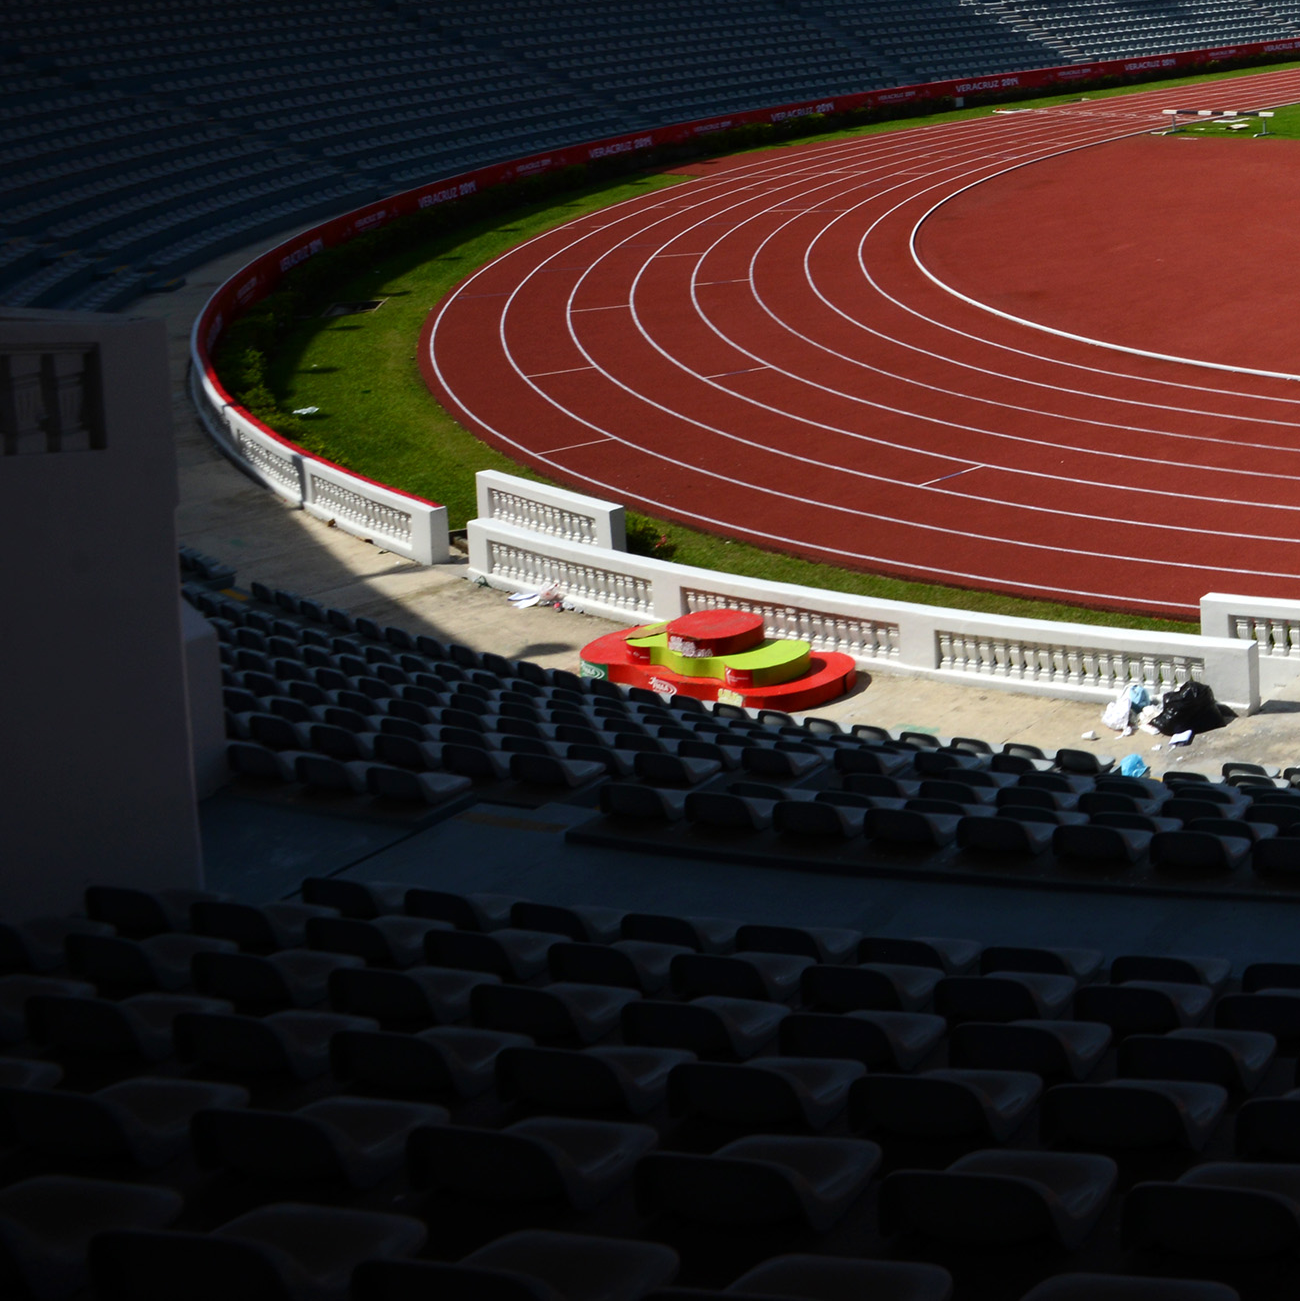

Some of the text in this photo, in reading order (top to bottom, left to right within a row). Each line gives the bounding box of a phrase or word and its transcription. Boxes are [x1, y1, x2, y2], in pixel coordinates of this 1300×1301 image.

[1125, 61, 1160, 71] VERACRUZ
[956, 77, 1018, 92] VERACRUZ 2014
[771, 106, 813, 122] VERACRUZ
[589, 141, 631, 158] VERACRUZ
[418, 187, 458, 209] VERACRUZ
